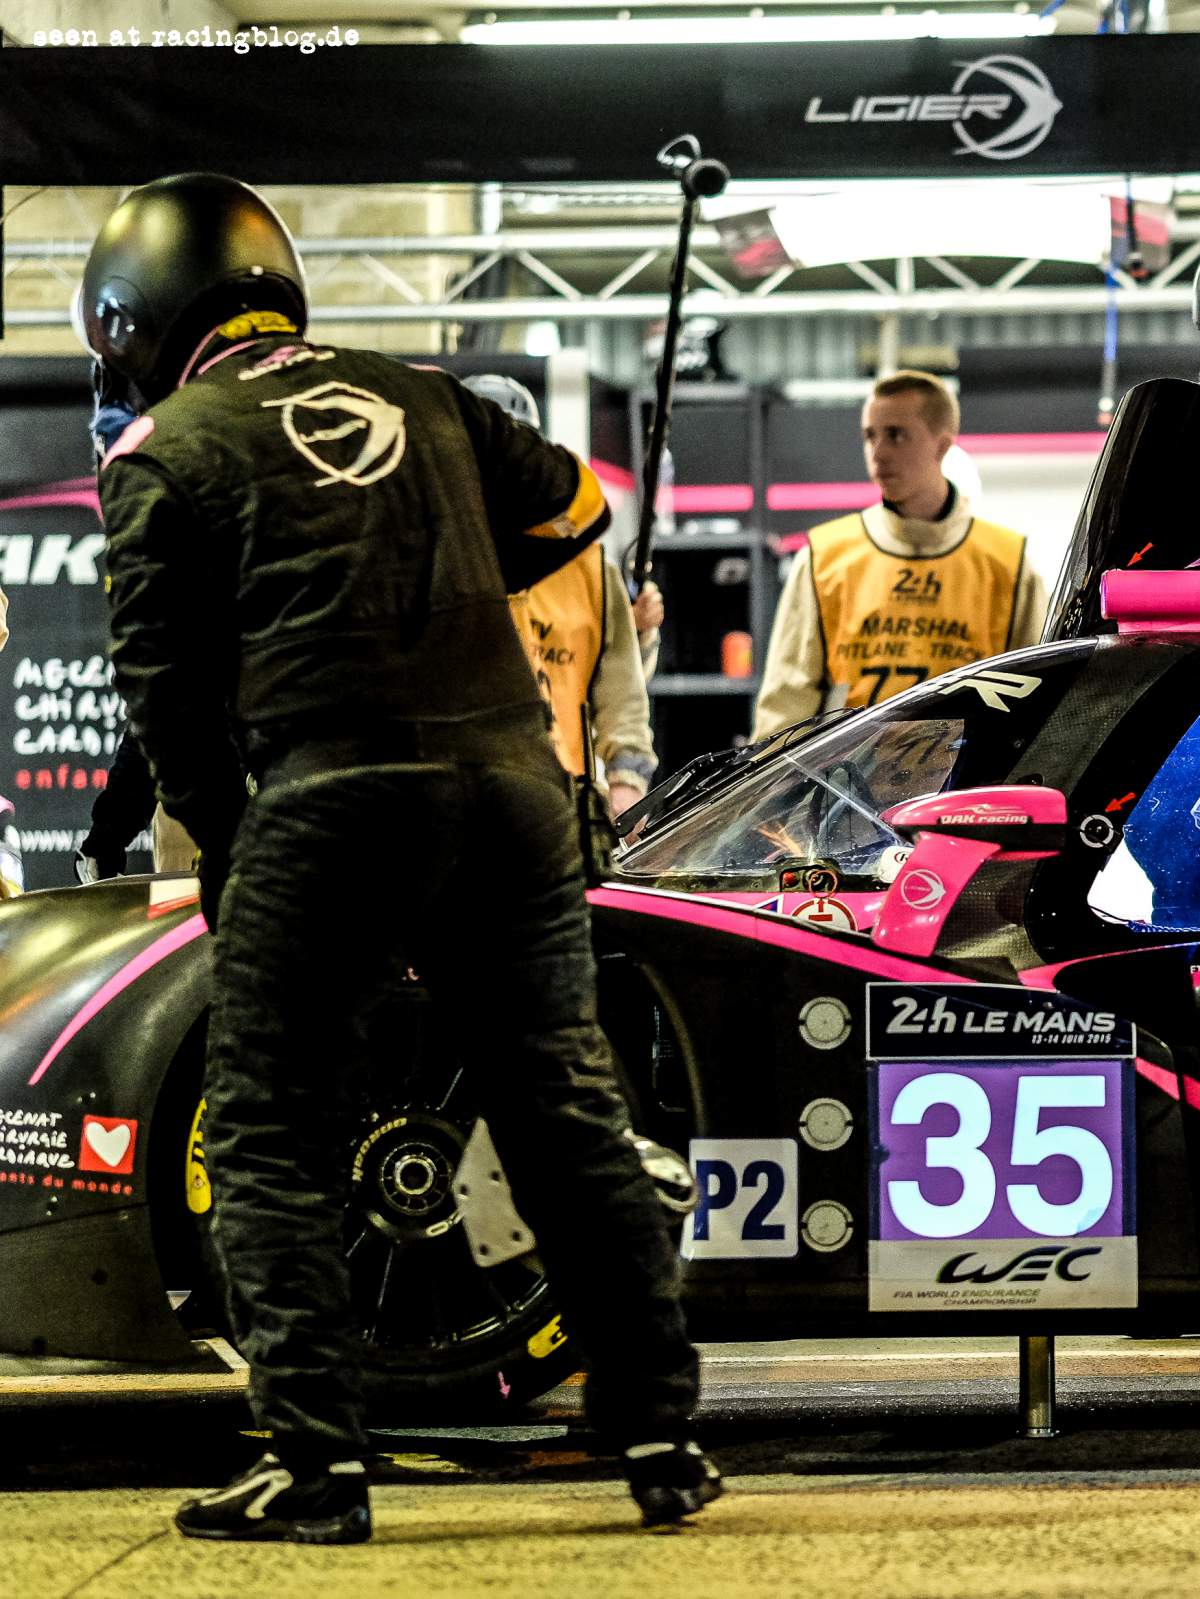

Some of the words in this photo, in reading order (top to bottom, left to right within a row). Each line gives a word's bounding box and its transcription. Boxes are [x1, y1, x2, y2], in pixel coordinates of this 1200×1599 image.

[804, 94, 1012, 122] LIGIER
[861, 612, 971, 641] MARSHAL
[837, 641, 908, 660] PITLANE
[978, 815, 1029, 825] racing
[886, 996, 958, 1034] 24h
[963, 1011, 1009, 1033] LE
[1012, 1011, 1116, 1033] MANS
[1087, 1033, 1112, 1044] 2015
[887, 1072, 1113, 1238] 35
[71, 1179, 133, 1196] monde
[693, 1160, 786, 1240] P2
[935, 1246, 1104, 1284] WEC
[893, 1290, 914, 1299] FIA
[916, 1289, 961, 1299] WORLD
[961, 1288, 1042, 1298] ENDURANCE
[944, 1297, 1037, 1306] CHAMPIONSHIP
